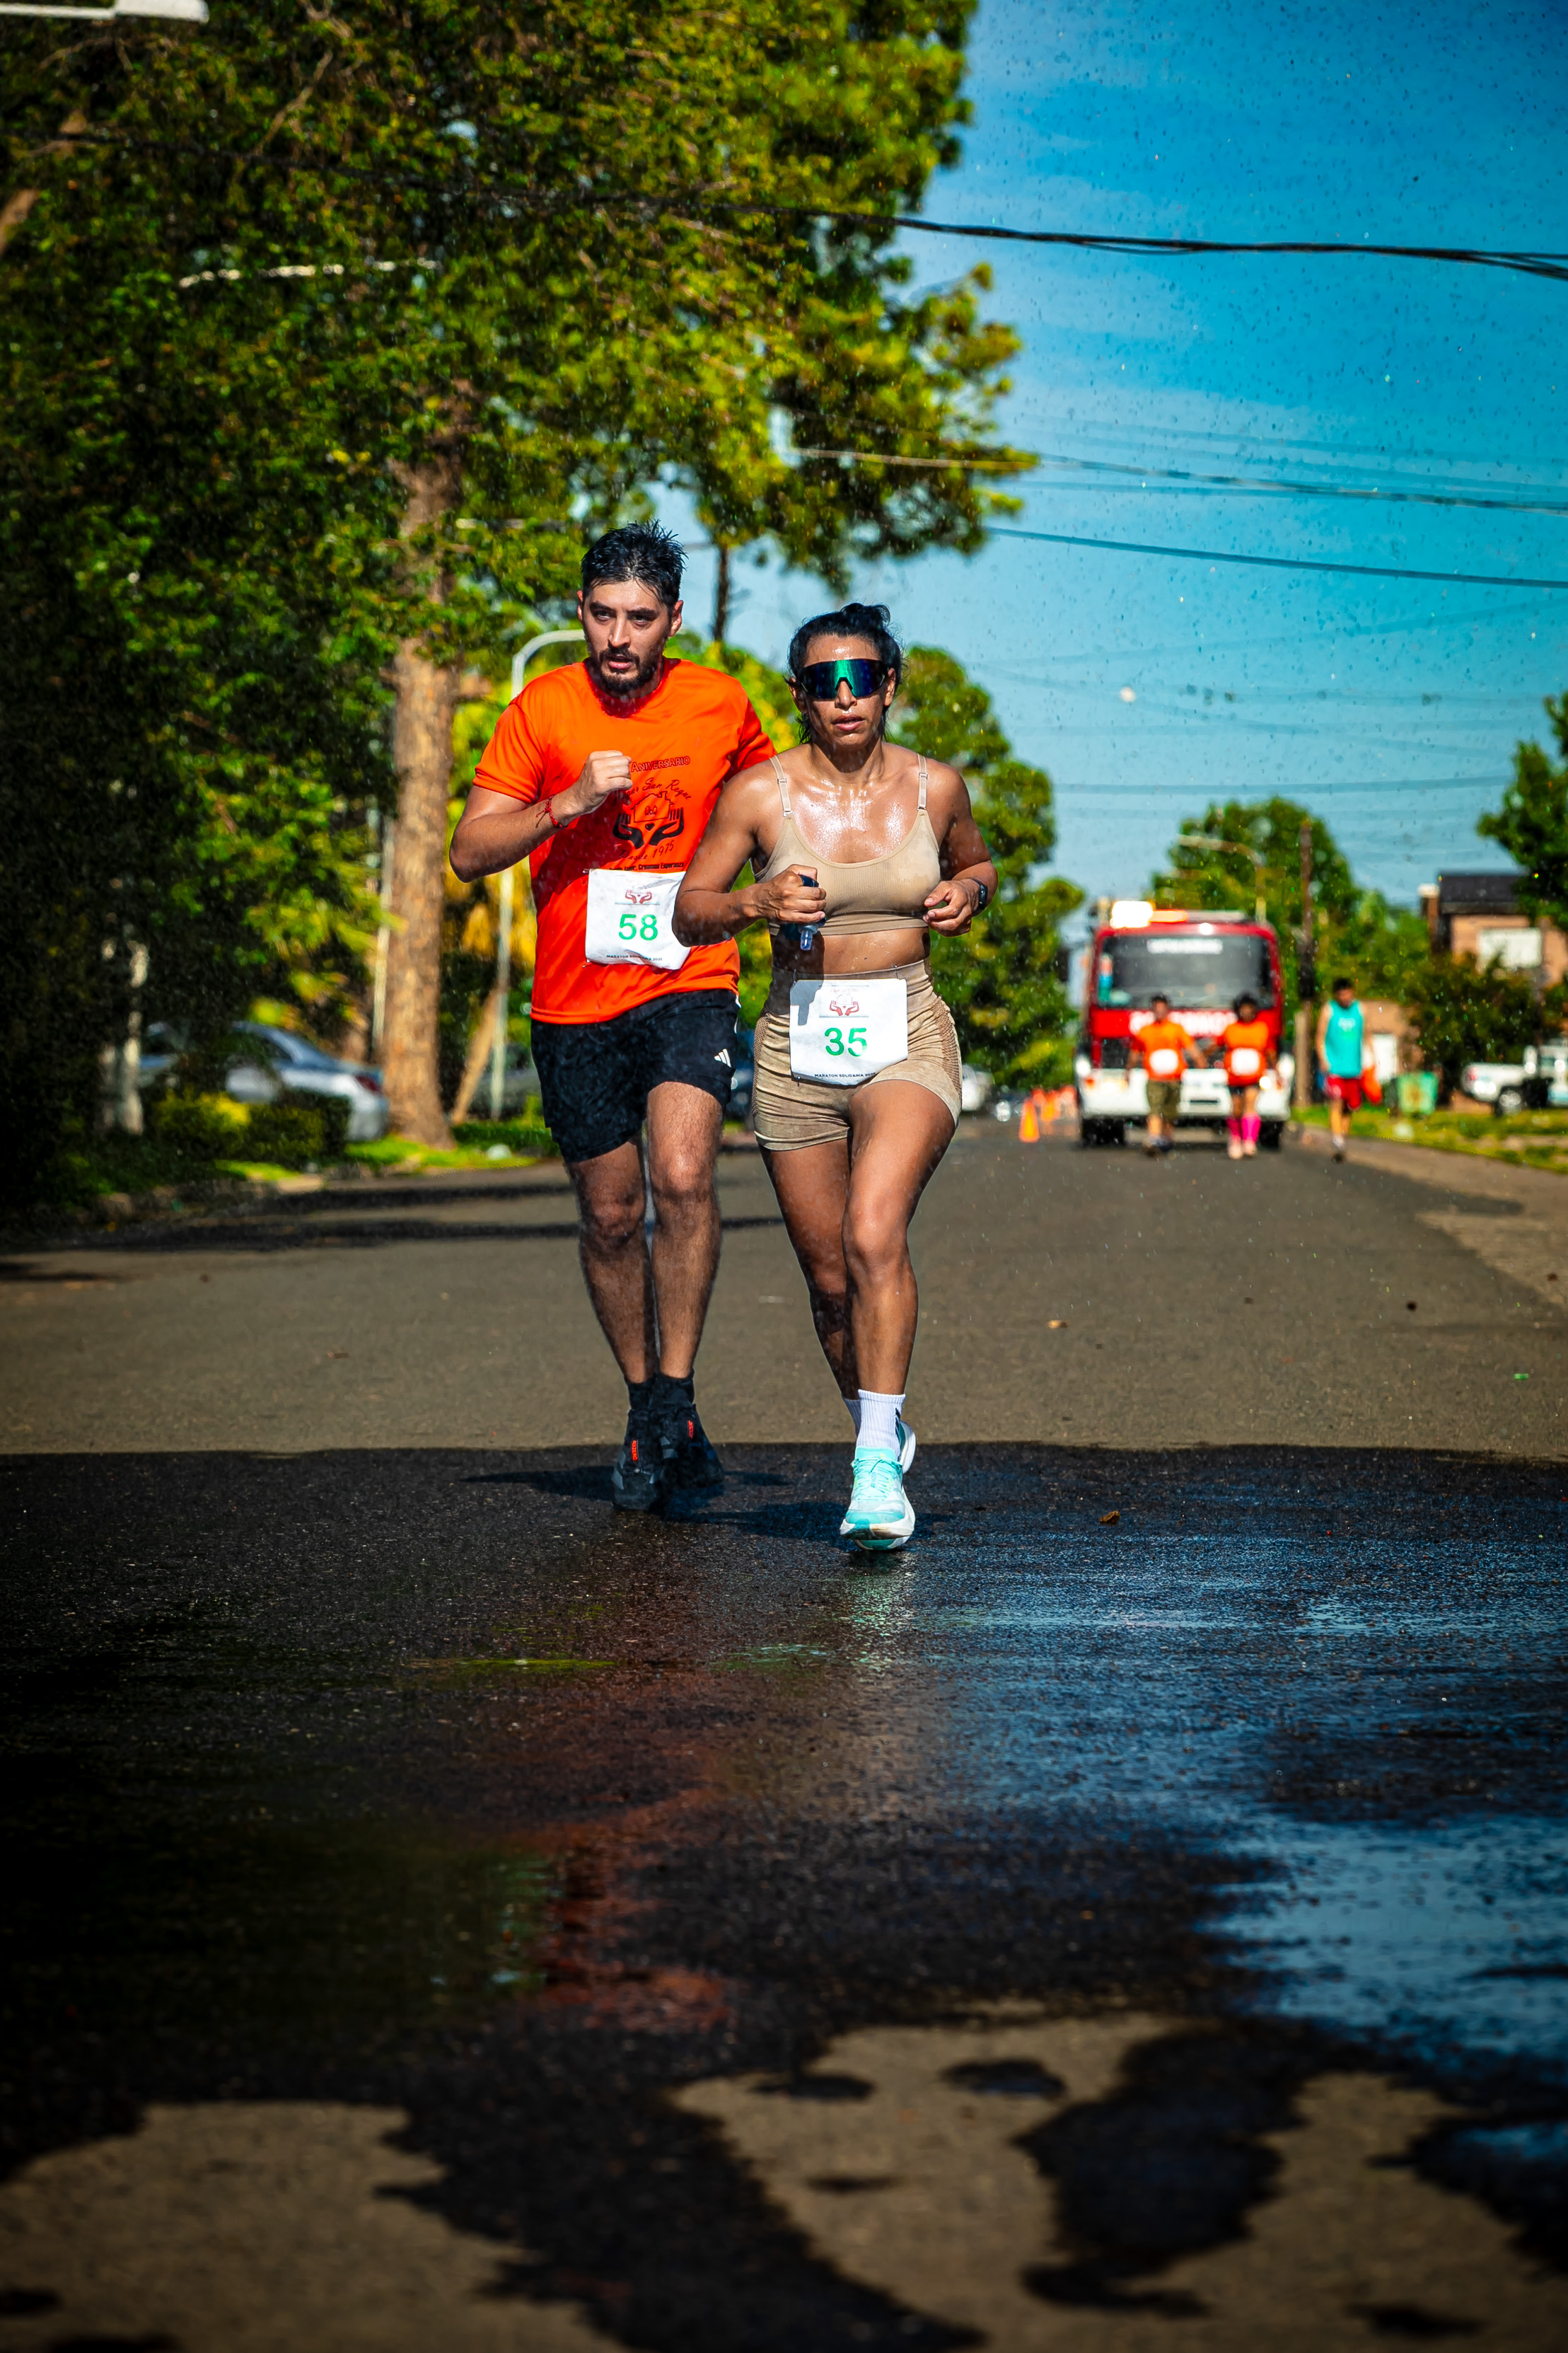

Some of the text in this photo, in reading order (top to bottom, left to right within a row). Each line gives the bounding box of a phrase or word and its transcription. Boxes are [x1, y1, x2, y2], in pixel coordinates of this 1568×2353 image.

[630, 756, 690, 772] ANIVERSARIO
[642, 777, 662, 790] San
[666, 779, 691, 799] Roque
[653, 840, 675, 858] 1975
[619, 914, 658, 940] 58
[825, 1027, 867, 1057] 35
